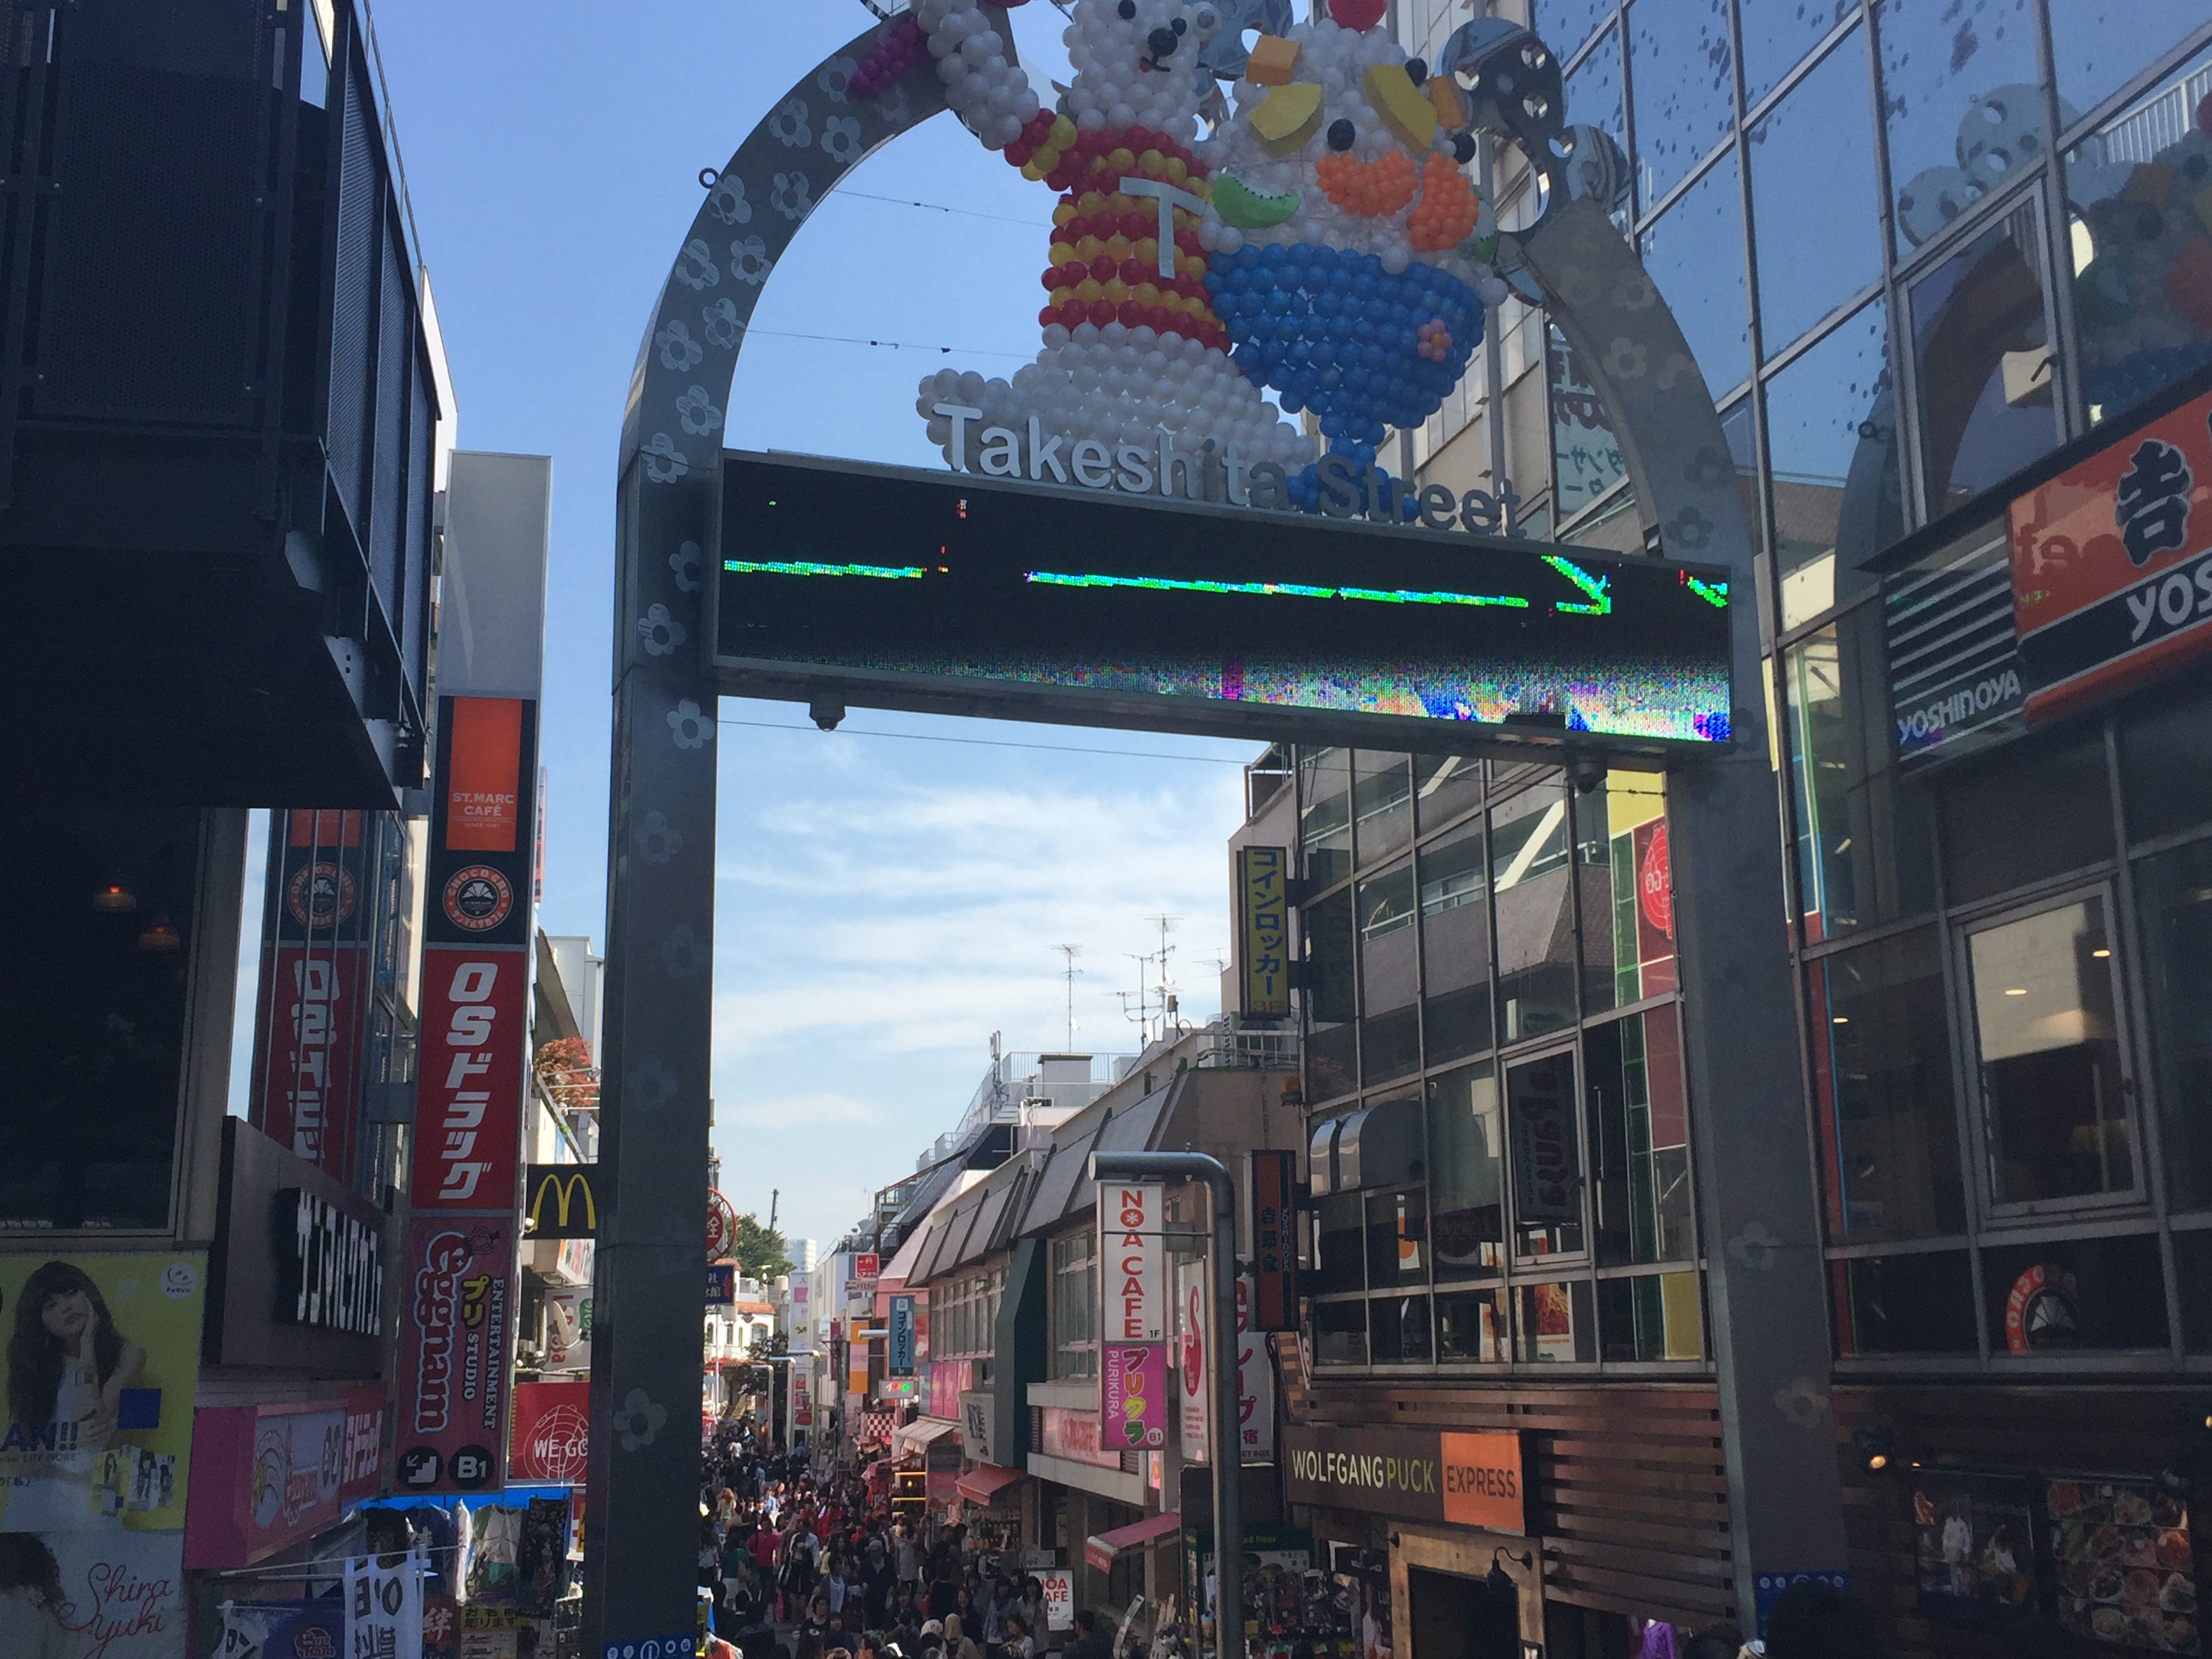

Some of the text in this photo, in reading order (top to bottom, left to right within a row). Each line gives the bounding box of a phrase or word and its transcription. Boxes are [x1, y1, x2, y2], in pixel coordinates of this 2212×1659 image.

[933, 405, 1525, 538] Takeshita Street
[2115, 410, 2212, 567] 吉
[1898, 668, 2022, 745] YOSHINOYA
[452, 792, 514, 804] ST.MARC
[464, 803, 502, 816] CAFÉ
[1252, 851, 1283, 996] コインロッカー
[437, 962, 499, 1200] OSドラッグ
[1120, 1189, 1145, 1338] NOA CAFE
[462, 1275, 490, 1401] プリ STUDIO
[483, 1277, 506, 1430] ENTERTAINMENT
[897, 1311, 907, 1366] コインロッカー
[1149, 1329, 1160, 1338] 1F
[1107, 1350, 1120, 1419] PURIKURA
[1122, 1347, 1150, 1445] プリクラ
[457, 1455, 488, 1479] B1
[1149, 1433, 1162, 1443] B1
[1291, 1449, 1435, 1494] WOLFGANG PUCK
[1446, 1465, 1516, 1499] EXPRESS
[1044, 1591, 1068, 1603] AFE
